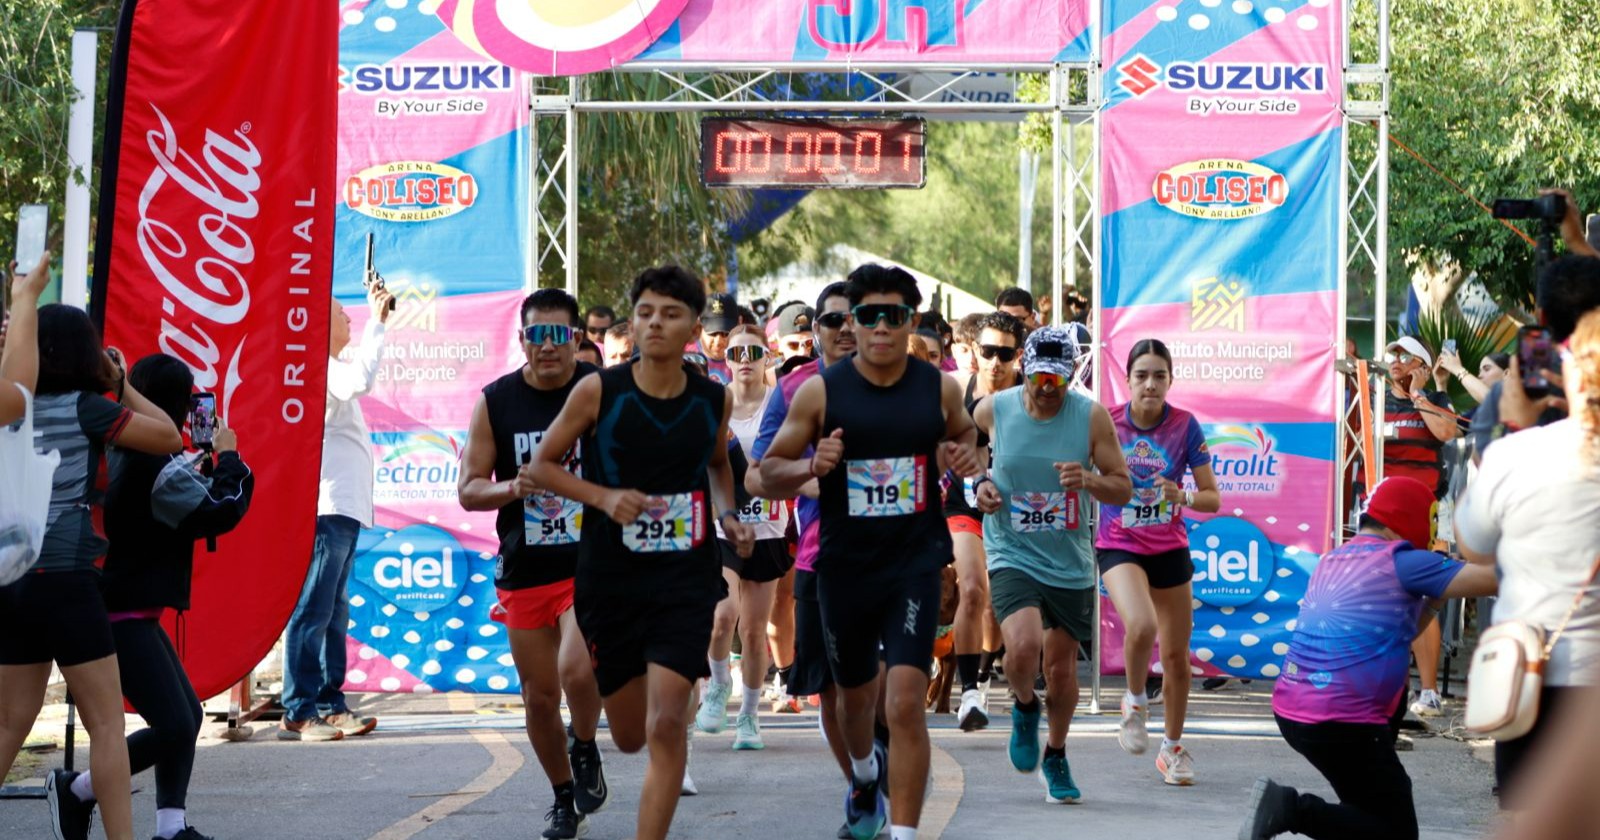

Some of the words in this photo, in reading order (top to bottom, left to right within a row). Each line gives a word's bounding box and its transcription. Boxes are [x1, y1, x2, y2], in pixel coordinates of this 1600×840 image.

[355, 65, 511, 92] SUZUKI
[1168, 65, 1324, 91] SUZUKI
[377, 101, 399, 115] By
[403, 101, 443, 113] Your
[446, 99, 484, 112] Side
[1190, 100, 1212, 113] By
[1215, 100, 1256, 112] Your
[1258, 100, 1297, 112] Side
[388, 163, 432, 172] ARENA
[1199, 161, 1243, 170] ARENA
[347, 174, 474, 209] COLISEO
[1156, 172, 1285, 205] COLISEO
[370, 207, 396, 219] TONY
[400, 208, 451, 220] ARELLANO
[1180, 204, 1205, 216] TONY
[137, 102, 263, 436] a-Cola
[281, 187, 317, 424] ORIGINAL
[409, 341, 485, 361] Municipal
[1167, 340, 1214, 358] tituto
[1217, 341, 1292, 362] Municipal
[376, 364, 389, 381] el
[394, 365, 456, 383] Deporte
[1172, 363, 1197, 379] del
[1201, 364, 1264, 382] Deporte
[376, 462, 458, 483] ectroli
[1211, 454, 1279, 476] trolit
[431, 489, 458, 499] TOTA
[863, 485, 899, 504] 119
[1238, 482, 1275, 491] TOTAL!
[737, 500, 762, 515] 66
[1020, 510, 1056, 524] 286
[1133, 503, 1160, 519] 191
[541, 517, 567, 535] 54
[635, 519, 677, 540] 292
[373, 542, 454, 588] ciel
[1192, 535, 1260, 582] ciel
[1201, 587, 1251, 595] purificada
